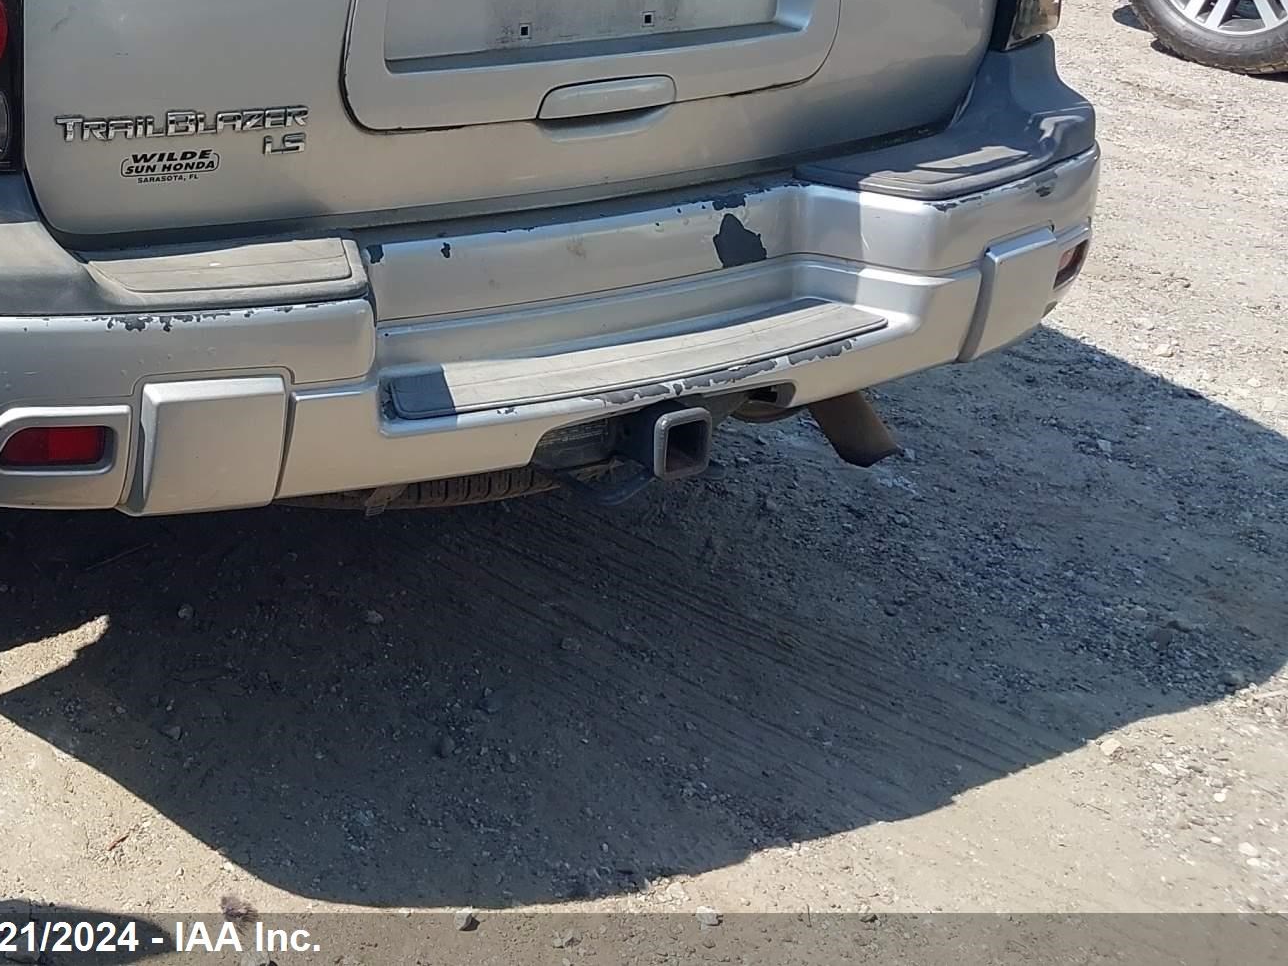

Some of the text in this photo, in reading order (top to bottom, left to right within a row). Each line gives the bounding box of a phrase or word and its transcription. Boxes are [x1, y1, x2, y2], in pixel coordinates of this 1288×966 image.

[263, 132, 307, 156] LS
[130, 149, 213, 166] WILDE
[124, 160, 216, 175] SUN HONDA
